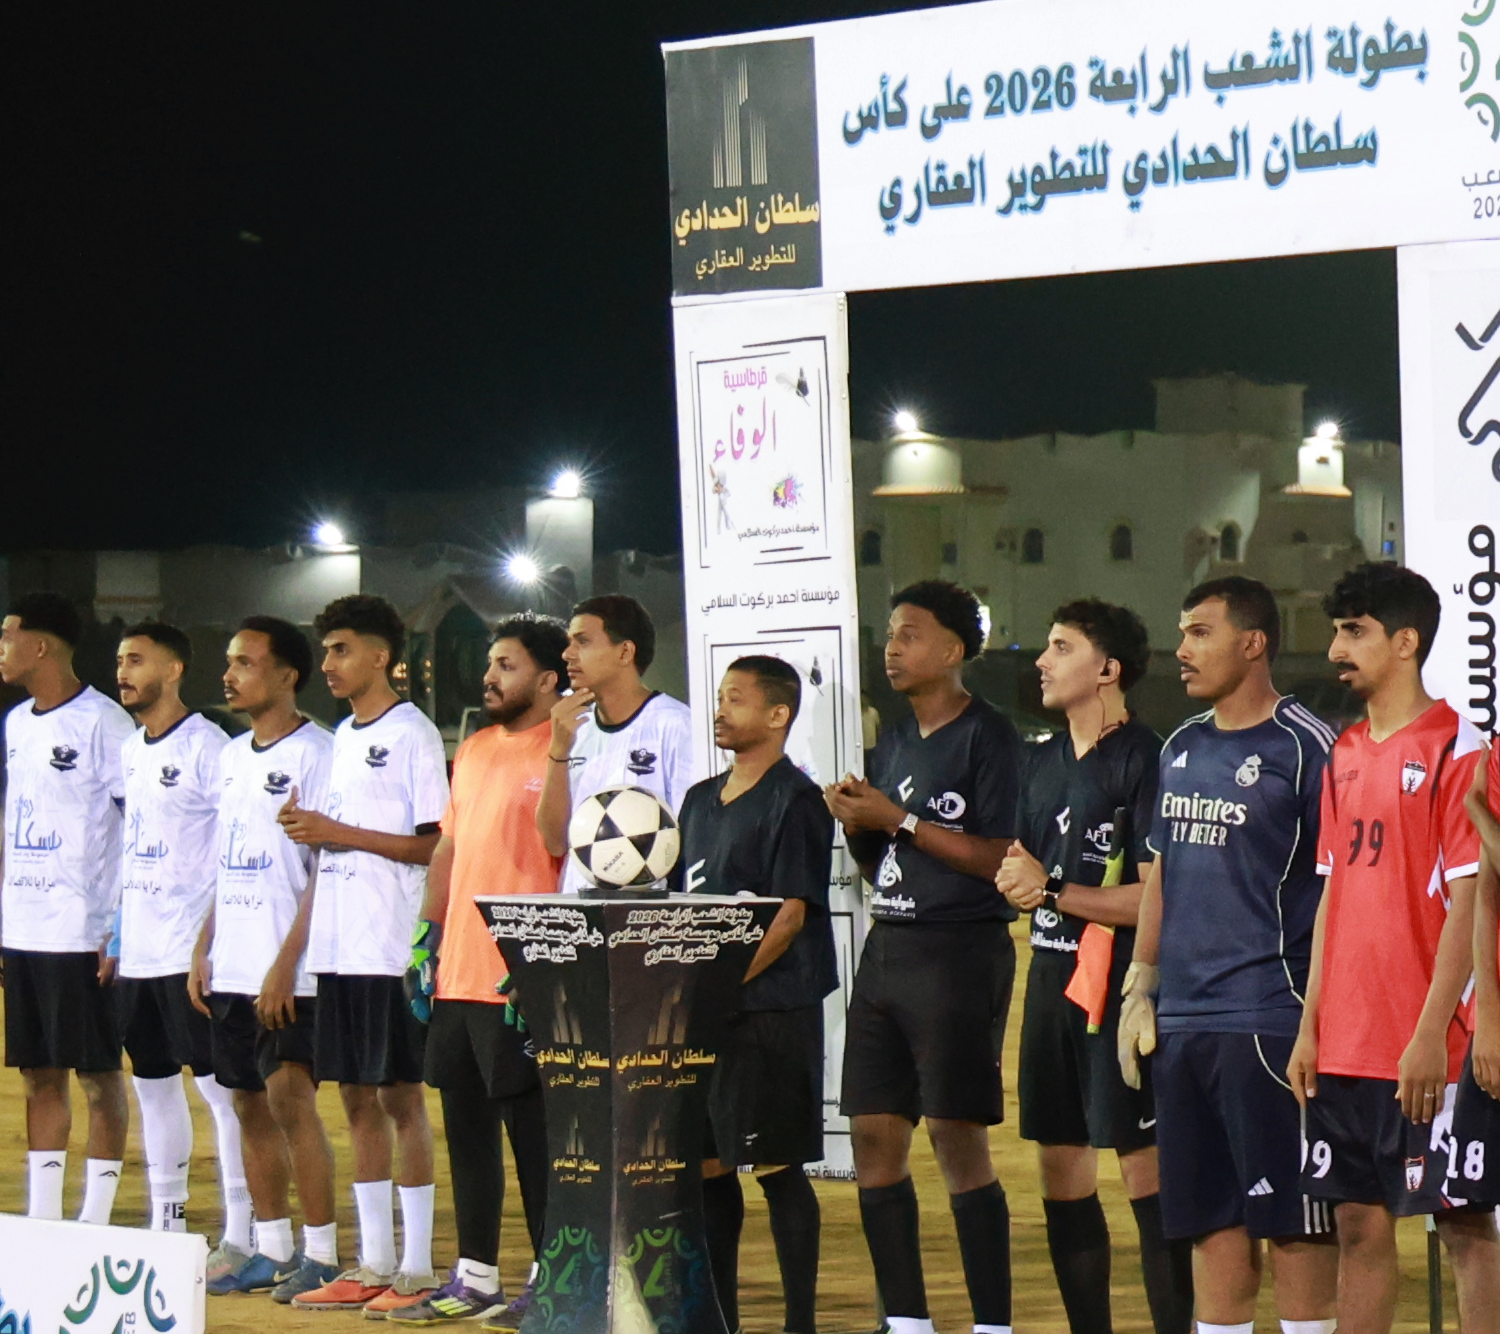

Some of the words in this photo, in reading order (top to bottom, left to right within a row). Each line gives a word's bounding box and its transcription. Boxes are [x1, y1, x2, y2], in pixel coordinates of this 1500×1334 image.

[1204, 24, 1313, 108] الشعب
[1325, 16, 1429, 88] بطولة
[984, 62, 1077, 119] 2026
[1088, 39, 1191, 117] الرابعة
[842, 71, 909, 146] كأس
[920, 68, 972, 142] على
[1123, 120, 1250, 213] الحدادي
[1262, 110, 1379, 190] سلطان
[879, 150, 987, 234] العقاري
[997, 138, 1112, 216] للتطوير
[674, 195, 748, 245] الحدادي
[755, 192, 820, 234] سلطان
[695, 247, 744, 279] العقاري
[748, 244, 796, 271] للتطوير
[723, 366, 768, 393] قرطاسية
[712, 396, 777, 464] الوفاء
[801, 586, 840, 606] مؤسسة
[1161, 792, 1248, 826] Emirates
[830, 871, 852, 891] مؤس
[626, 909, 658, 925] 2026
[536, 1048, 575, 1068] الحدادي
[578, 1050, 610, 1070] سلطان
[616, 1050, 669, 1074] الحدادي
[671, 1049, 716, 1069] سلطان
[627, 1075, 662, 1092] العقاري
[665, 1074, 697, 1088] للتطوير
[1446, 1135, 1486, 1182] 18
